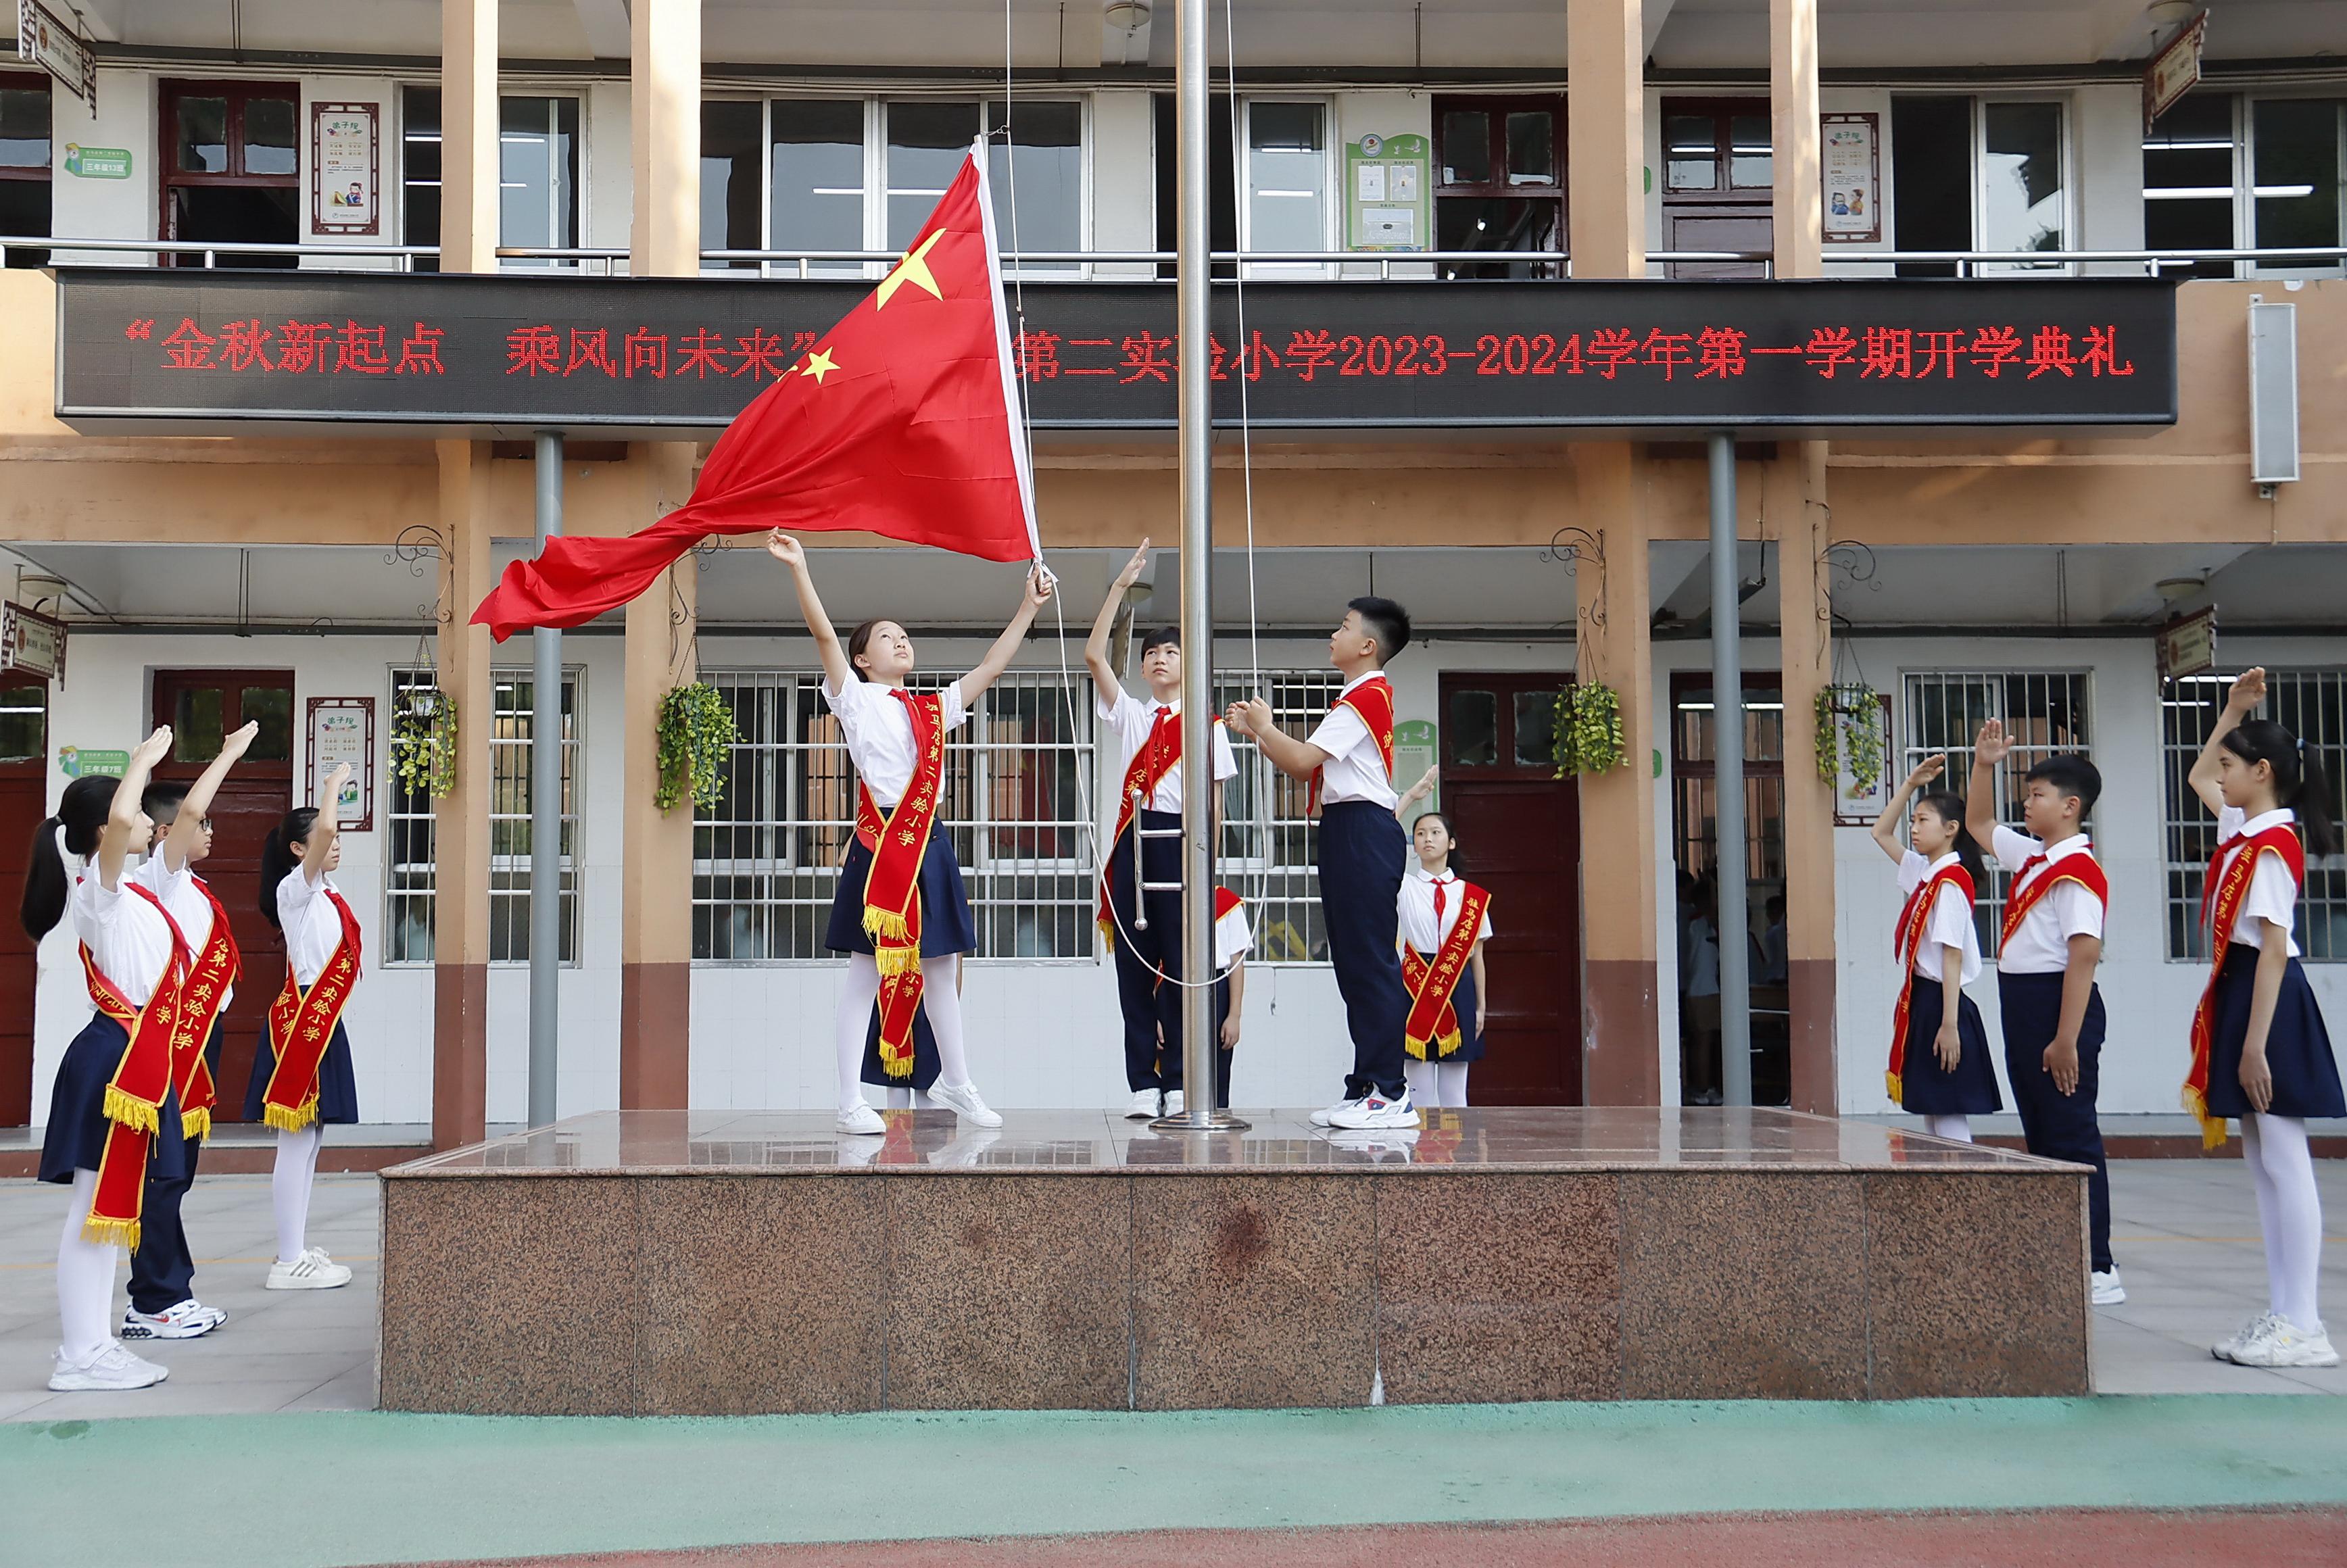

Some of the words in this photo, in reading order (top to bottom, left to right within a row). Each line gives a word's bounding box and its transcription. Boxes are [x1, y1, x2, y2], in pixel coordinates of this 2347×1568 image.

[125, 318, 445, 374] “金秋新起点
[506, 326, 816, 383] 乘风向未来”
[1430, 897, 1480, 998] 驻马店第二实验小学
